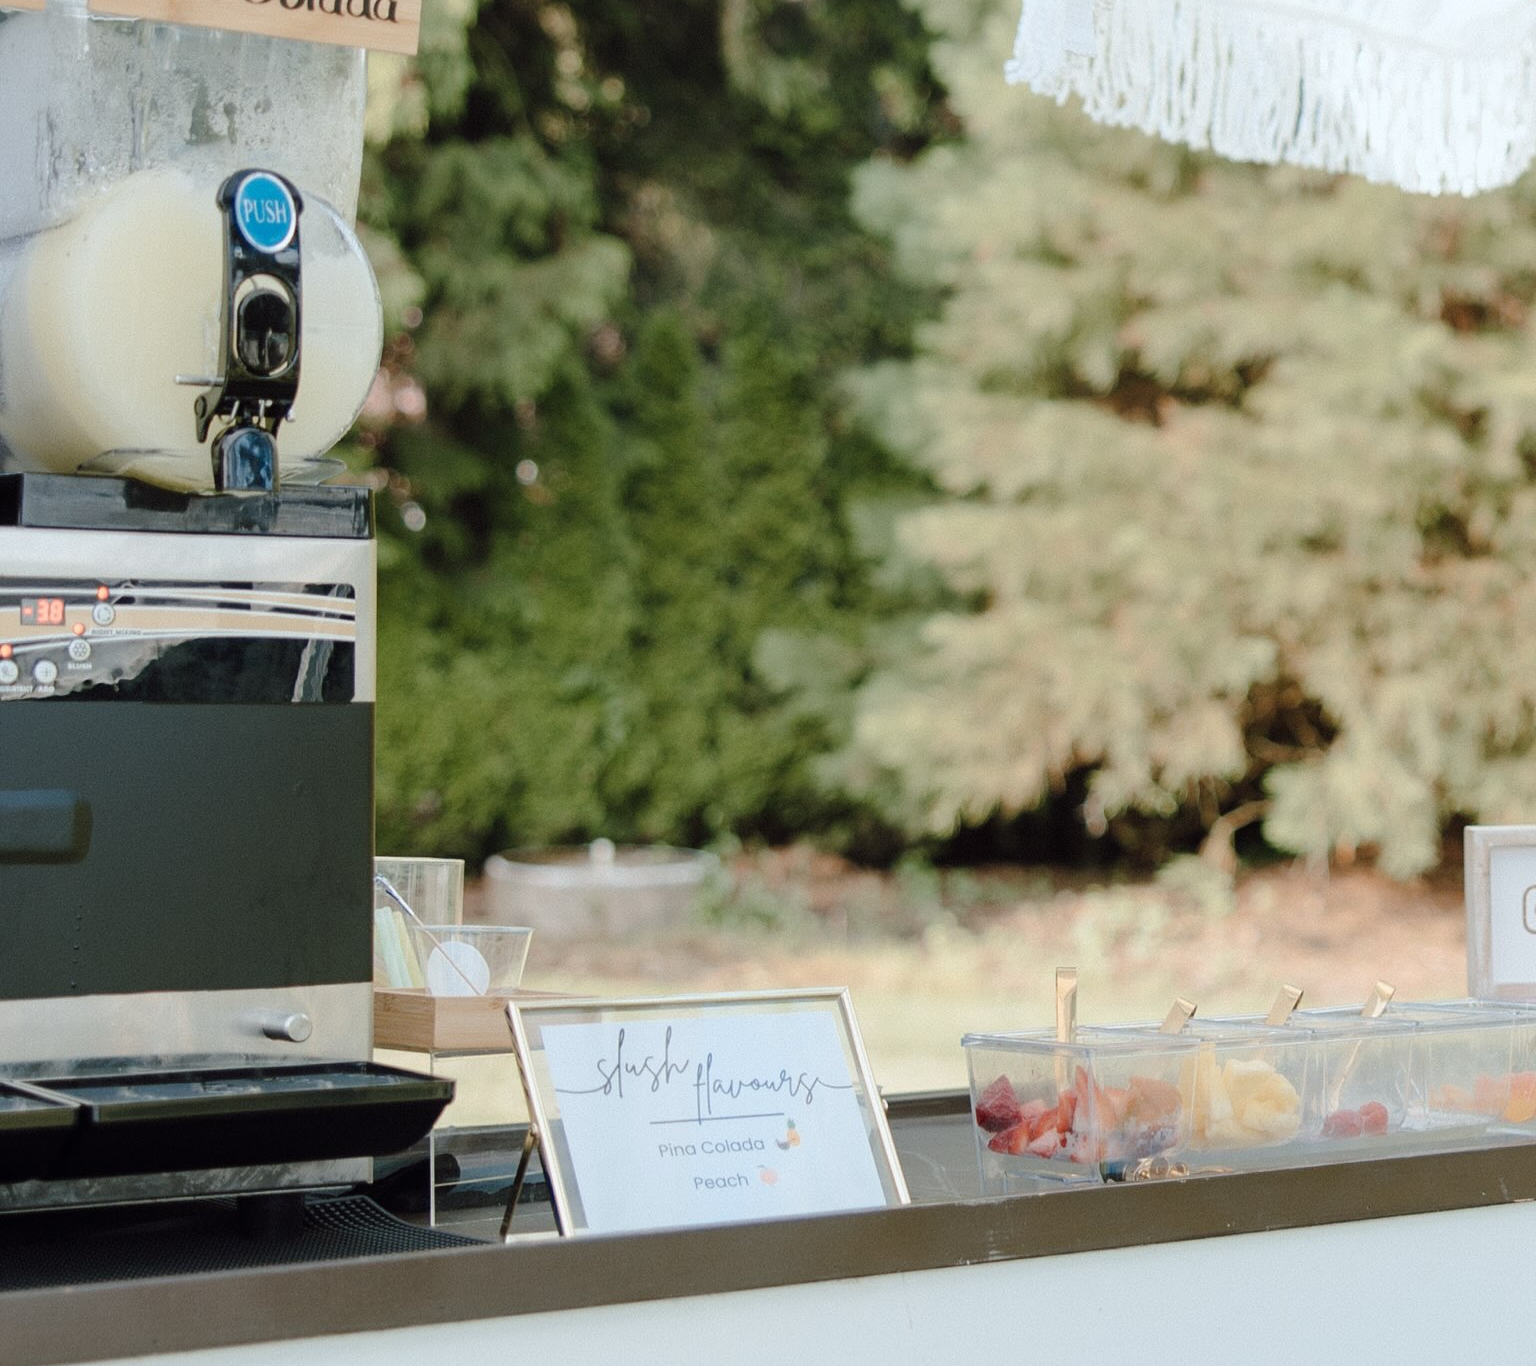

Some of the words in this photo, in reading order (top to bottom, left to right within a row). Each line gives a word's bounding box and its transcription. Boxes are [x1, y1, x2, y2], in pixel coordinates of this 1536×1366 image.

[243, 199, 288, 224] PUSH
[67, 662, 93, 670] SLUSH
[556, 1025, 690, 1099] slush
[693, 1052, 854, 1125] flavours
[658, 1142, 697, 1158] Pina
[700, 1136, 766, 1155] Colada
[693, 1173, 750, 1190] Peach
